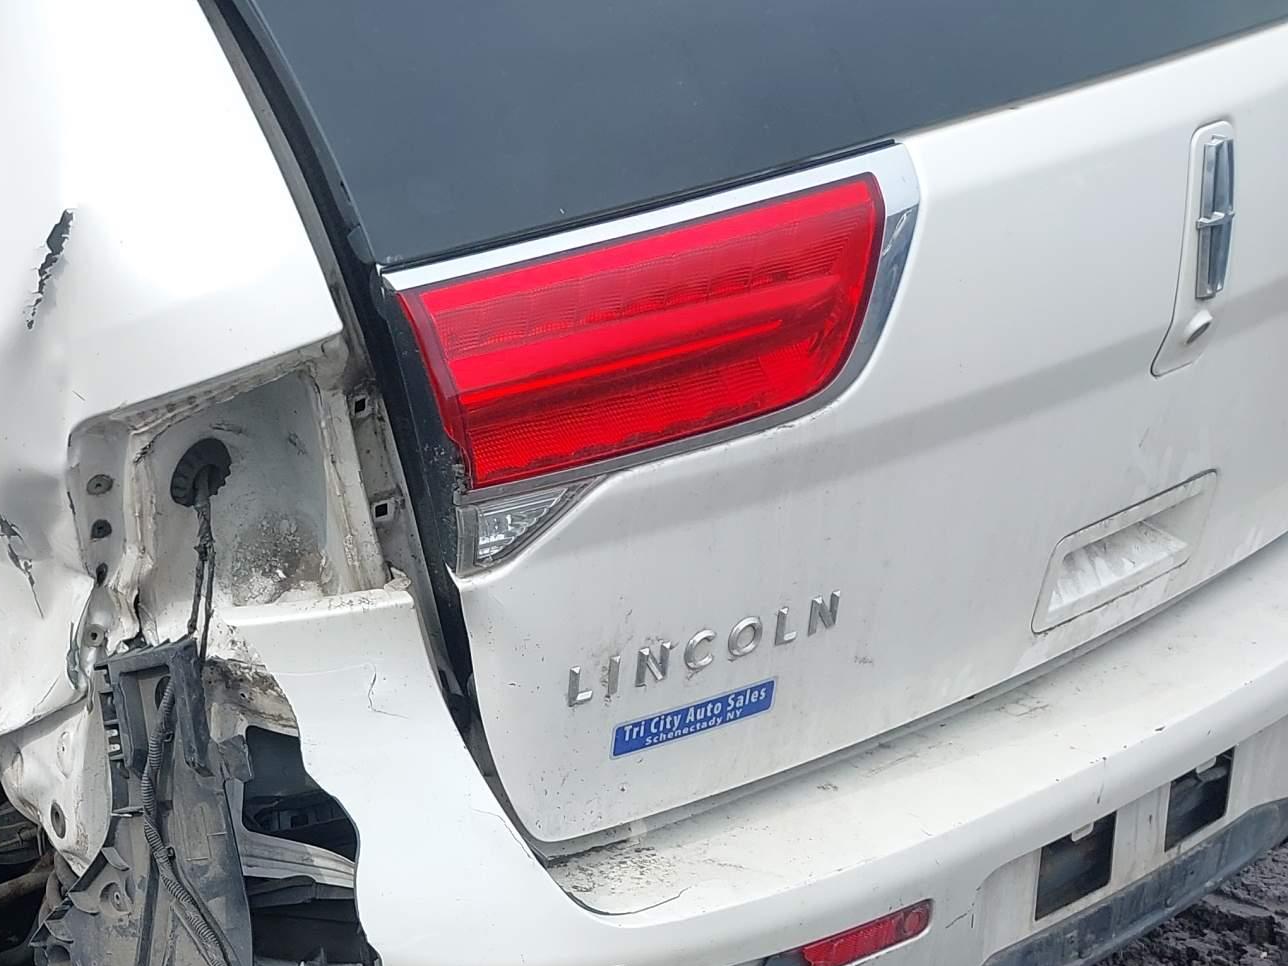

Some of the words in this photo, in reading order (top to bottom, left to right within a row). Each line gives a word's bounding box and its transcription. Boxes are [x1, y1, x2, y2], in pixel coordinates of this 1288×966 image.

[567, 590, 841, 706] LINCOLN
[623, 721, 645, 741] Tri
[650, 713, 681, 734] City
[686, 703, 722, 724] Auto
[727, 687, 766, 711] Sales
[645, 716, 723, 746] Schenectady
[726, 708, 743, 721] NY
